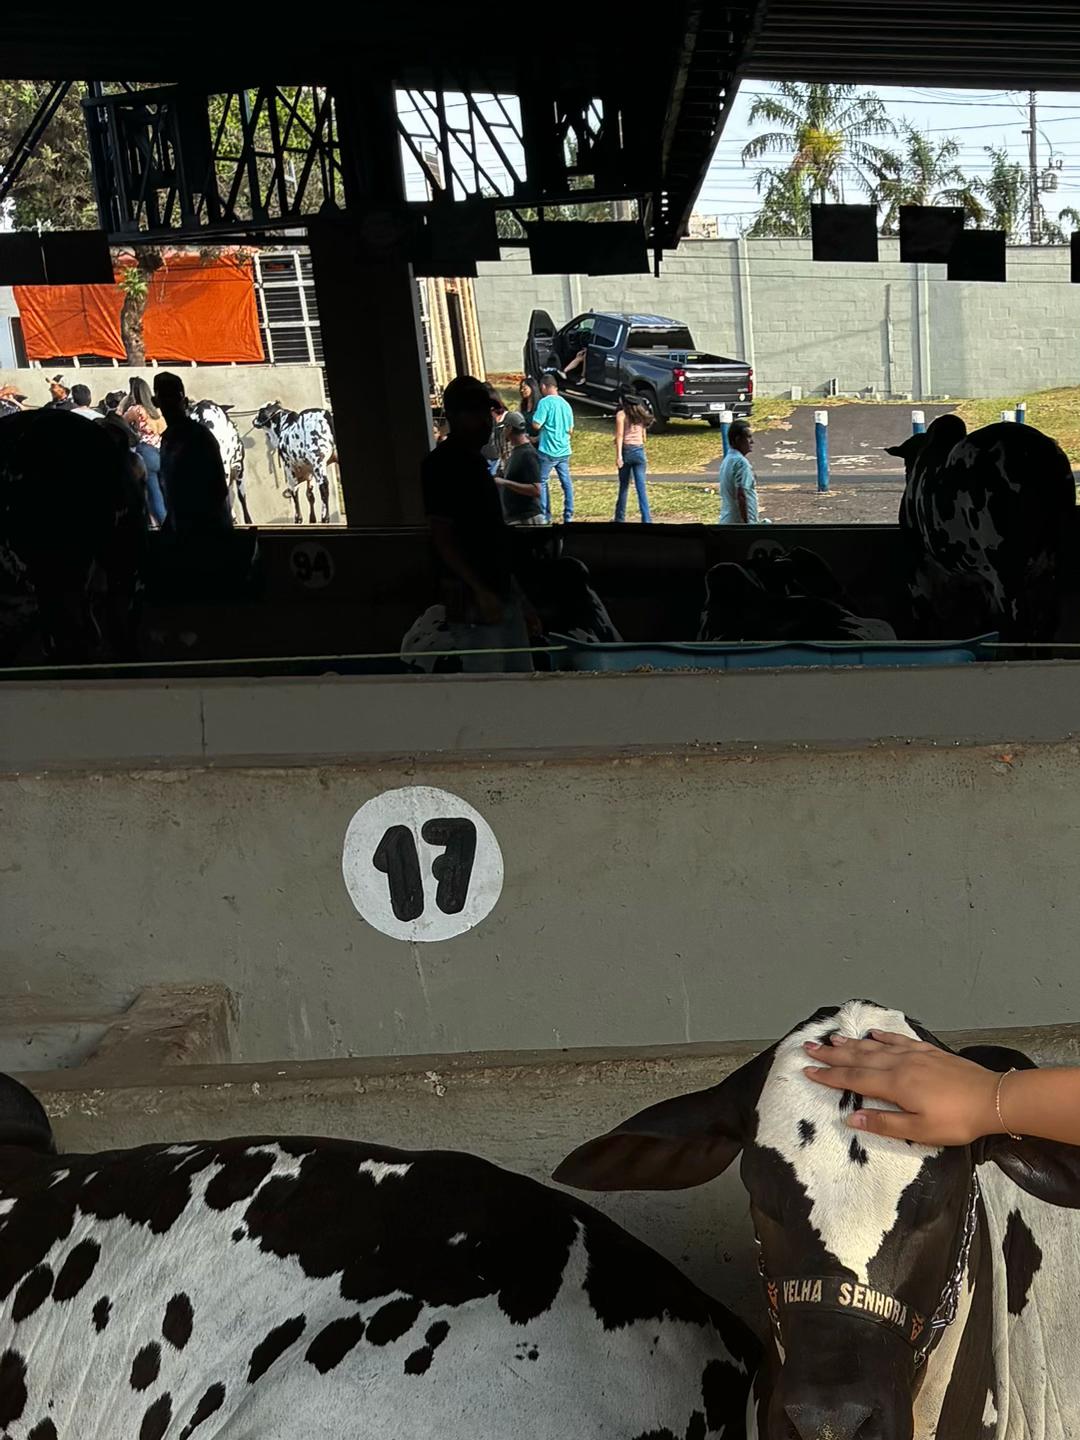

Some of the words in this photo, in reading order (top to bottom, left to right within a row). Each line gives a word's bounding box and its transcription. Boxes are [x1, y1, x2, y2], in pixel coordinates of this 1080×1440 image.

[372, 816, 478, 923] 17
[783, 1279, 823, 1304] VELHA
[838, 1282, 908, 1327] SENHORA
